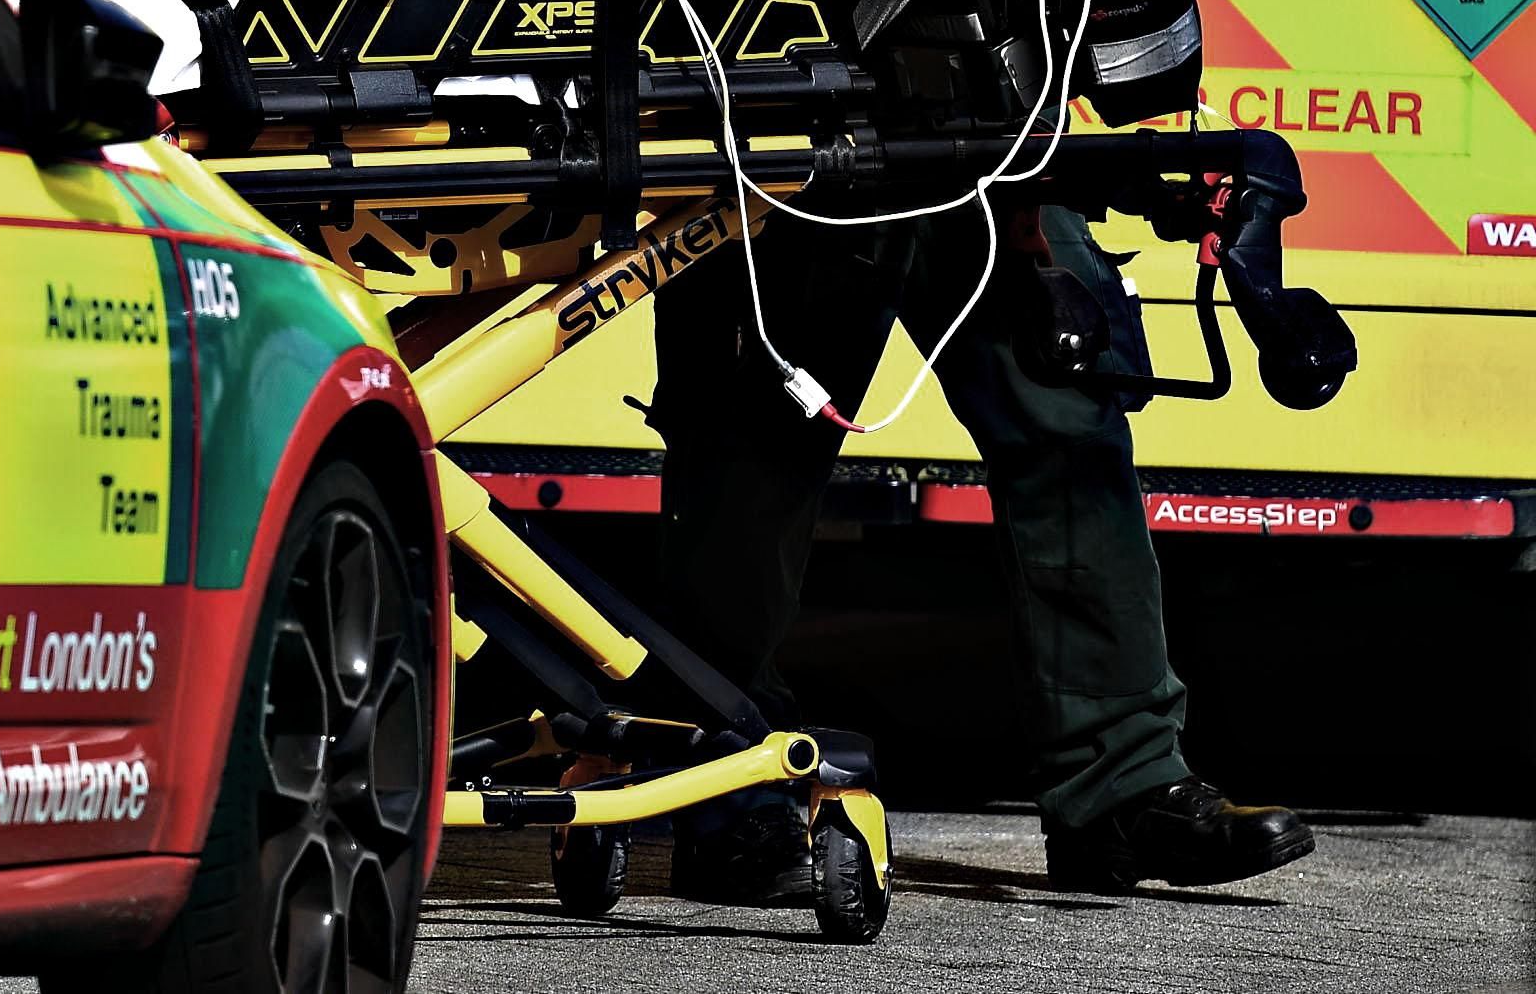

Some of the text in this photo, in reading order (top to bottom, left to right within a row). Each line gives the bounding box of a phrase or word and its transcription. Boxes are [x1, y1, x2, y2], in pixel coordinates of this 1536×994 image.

[1229, 86, 1423, 135] CLEAR
[558, 198, 736, 352] stryker
[46, 284, 158, 343] Advanced
[76, 378, 161, 438] Trauma
[100, 474, 159, 534] Team
[19, 610, 156, 693] London's
